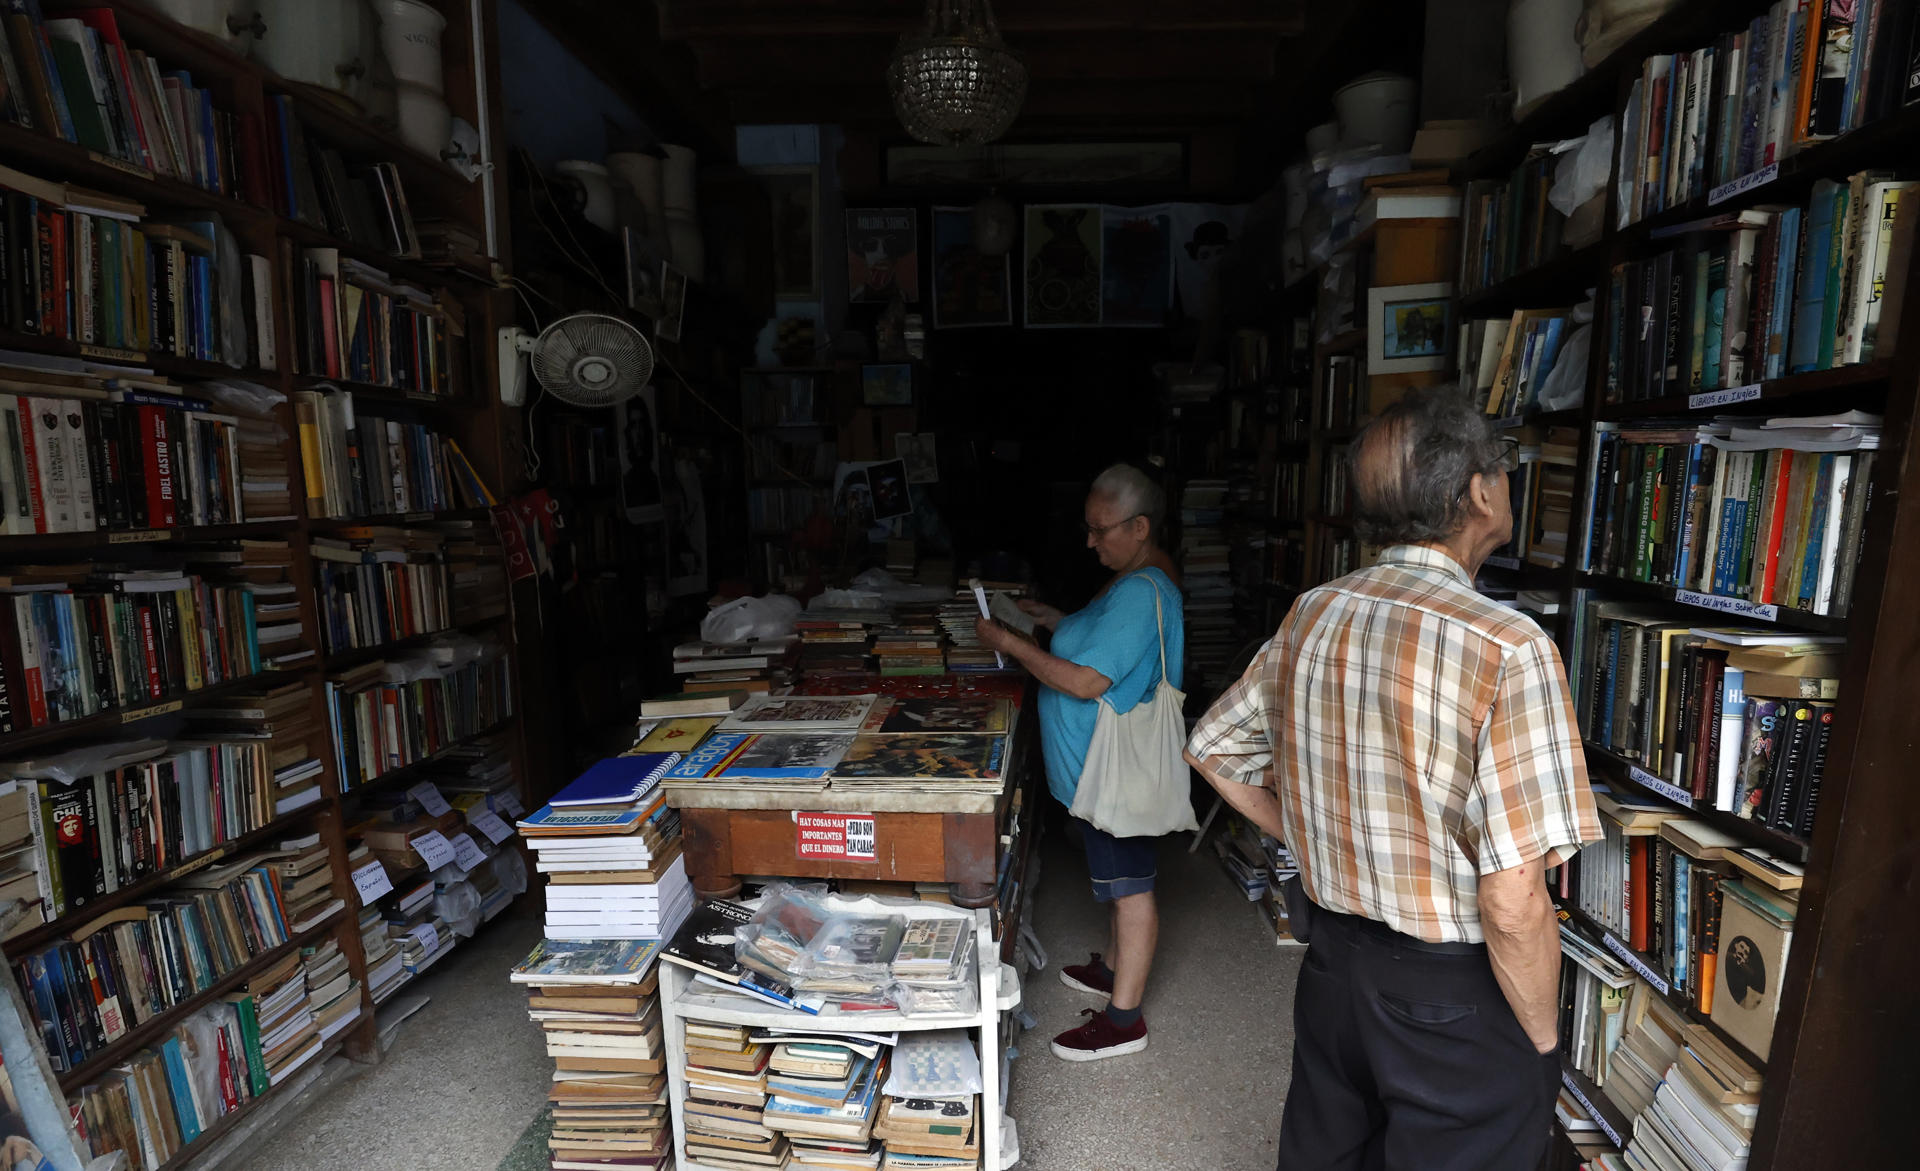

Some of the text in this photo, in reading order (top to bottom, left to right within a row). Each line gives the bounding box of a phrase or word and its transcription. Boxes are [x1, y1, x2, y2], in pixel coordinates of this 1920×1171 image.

[157, 441, 173, 501] FIDEL CASTRO
[1636, 471, 1653, 562] FIDEL CASTRO READER
[1719, 518, 1729, 548] Bolivian
[1711, 713, 1722, 749] KOONTZ
[683, 735, 741, 776] aragon
[53, 805, 83, 824] CHE
[800, 817, 845, 828] HAY COSAS MAS
[802, 830, 843, 841] IMPORTANTES
[863, 821, 873, 836] SON
[801, 843, 844, 855] QUE EL DINERO
[847, 839, 856, 853] TAN
[707, 904, 752, 921] ASTRONO
